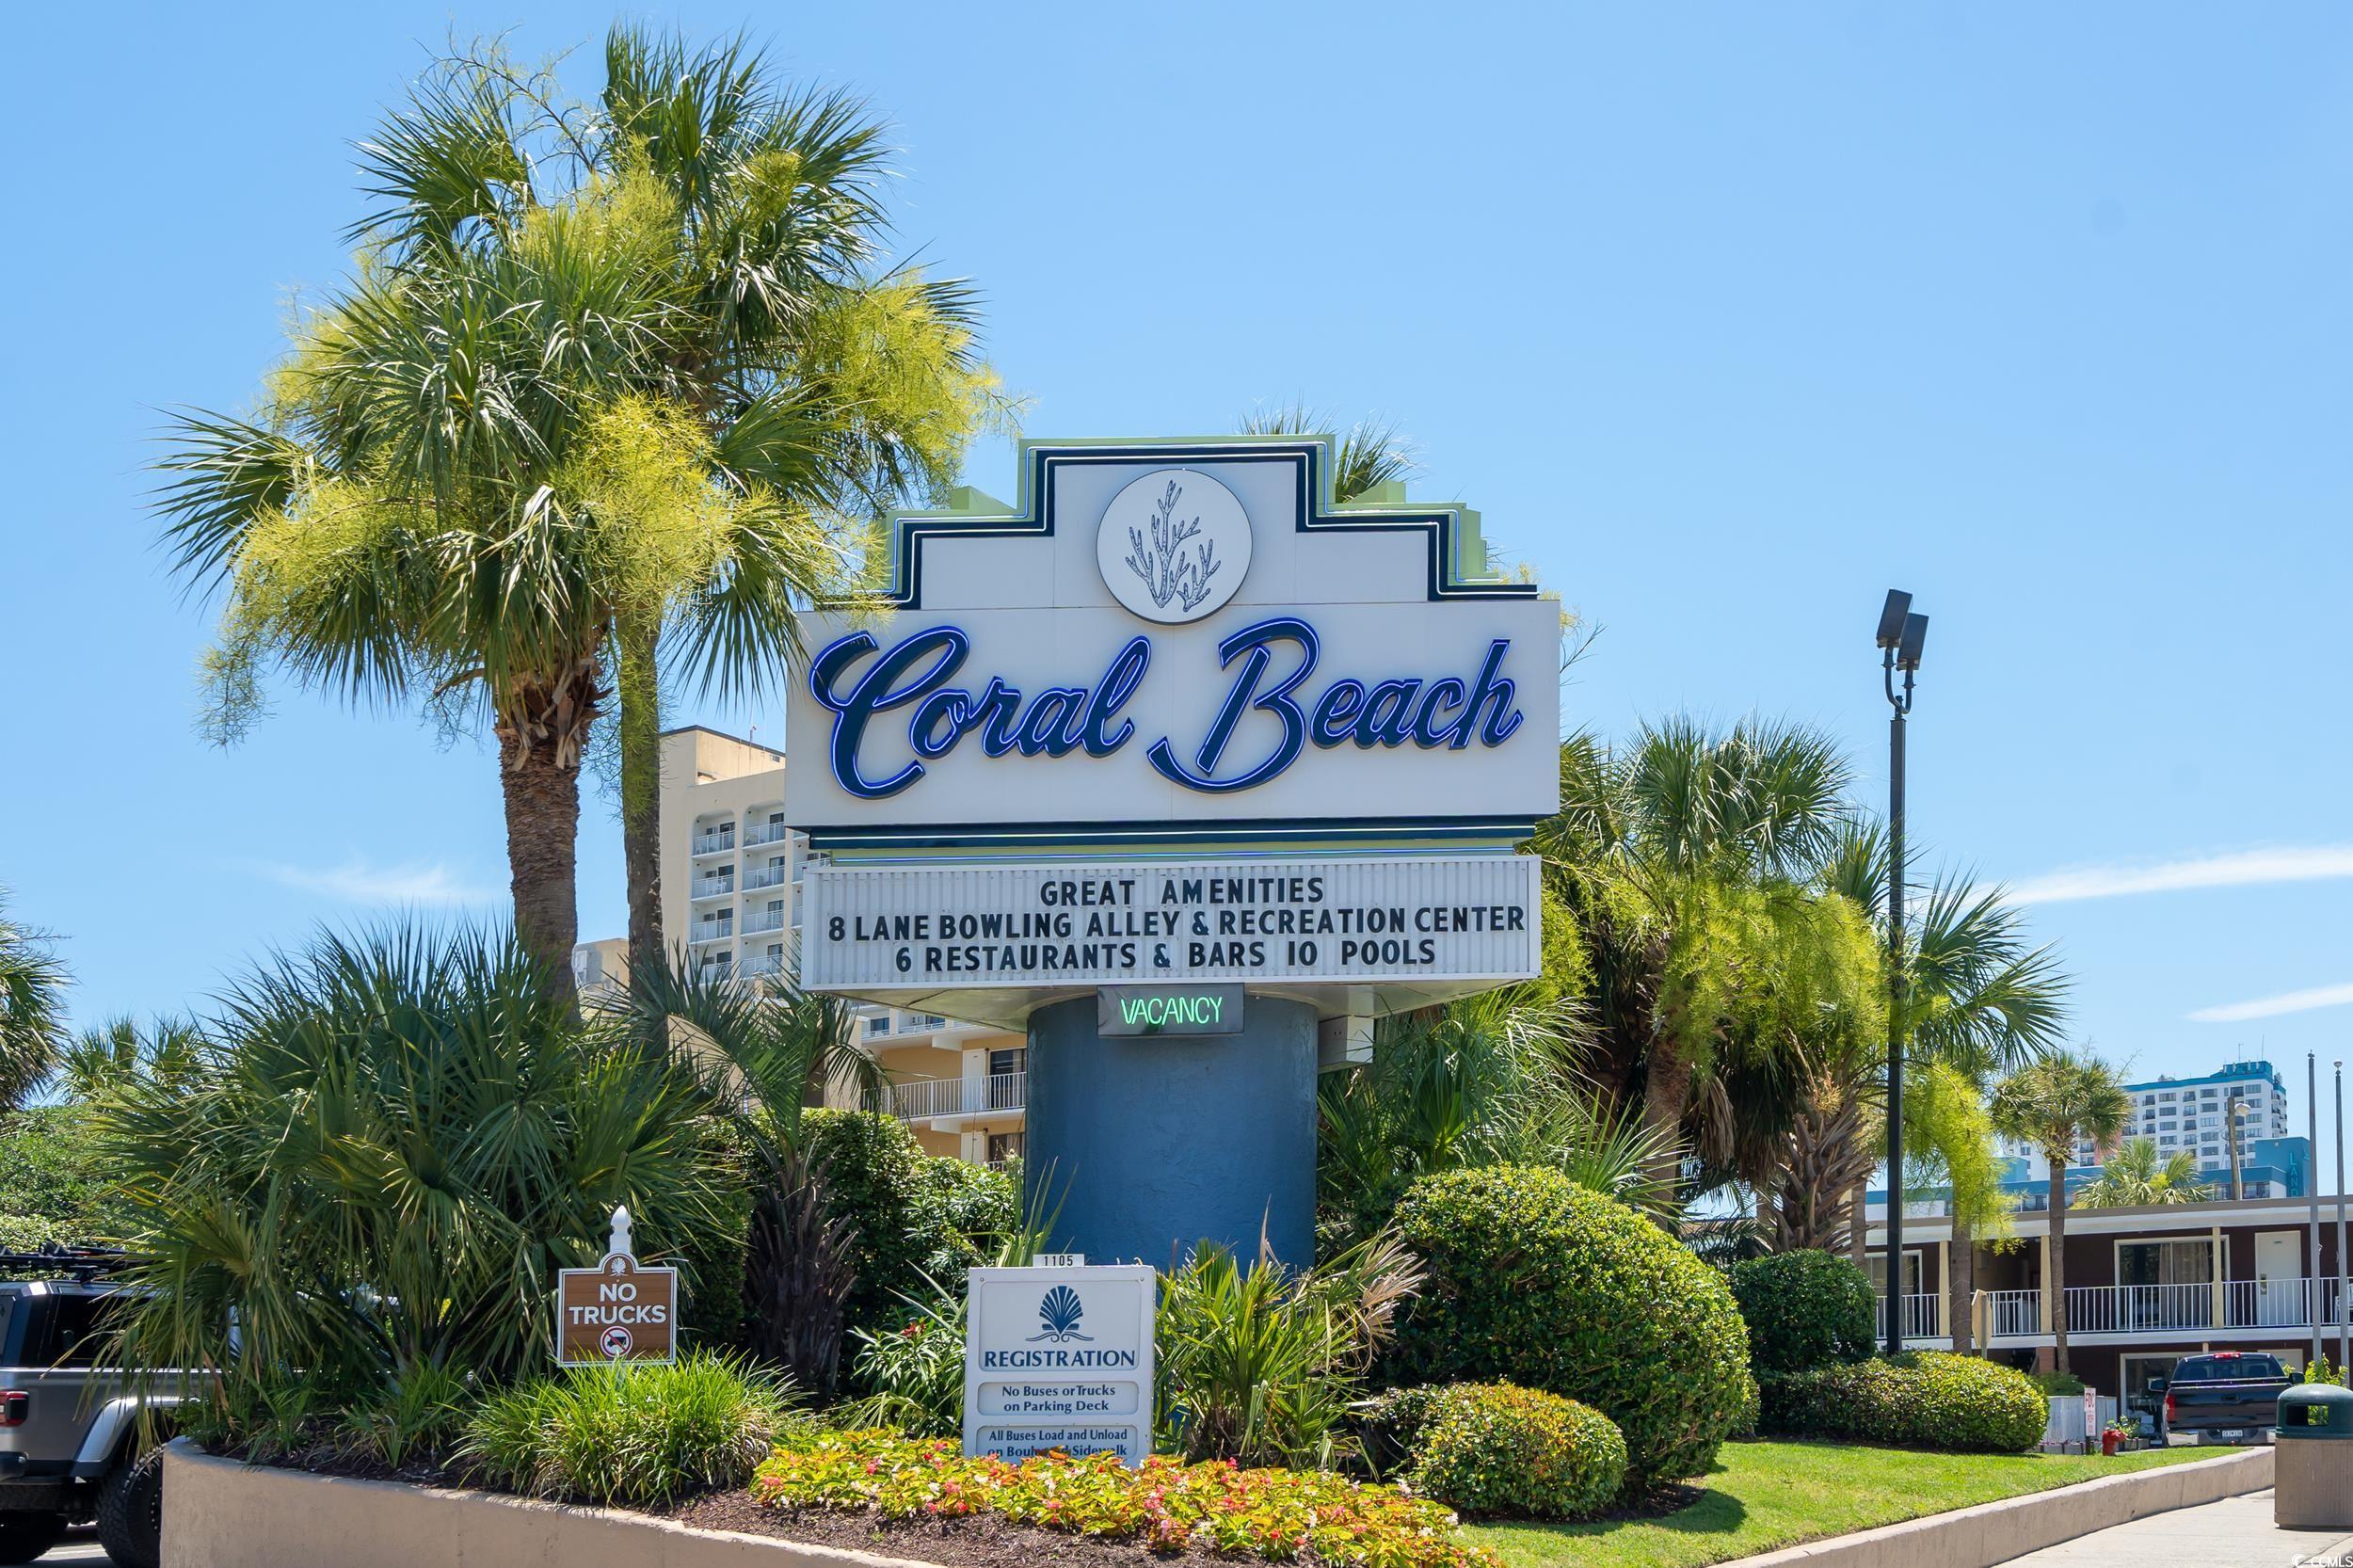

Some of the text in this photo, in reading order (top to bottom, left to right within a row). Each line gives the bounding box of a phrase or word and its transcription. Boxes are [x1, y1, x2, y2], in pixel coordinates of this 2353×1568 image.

[810, 617, 1524, 800] Coral Beach
[1040, 877, 1323, 906] GREAT AMENITIES
[828, 905, 1524, 941] 8 LANE BOWLING ALLEY & RECREATION CENTER
[896, 947, 911, 972] 6
[926, 943, 1136, 971] RESTAURANTS
[1154, 943, 1172, 968] &
[1189, 941, 1265, 968] BARS
[1341, 938, 1435, 965] POOLS
[1120, 996, 1223, 1026] VACANCY
[1044, 1255, 1073, 1267] 1105
[600, 1283, 637, 1302] NO
[568, 1304, 666, 1325] TRUCKS
[984, 1350, 1135, 1368] REGISTRATION
[1001, 1384, 1115, 1397] No Buses or Trucks
[1003, 1400, 1110, 1415] on Parking Deck
[989, 1429, 1128, 1441] All Buses Load and Unload
